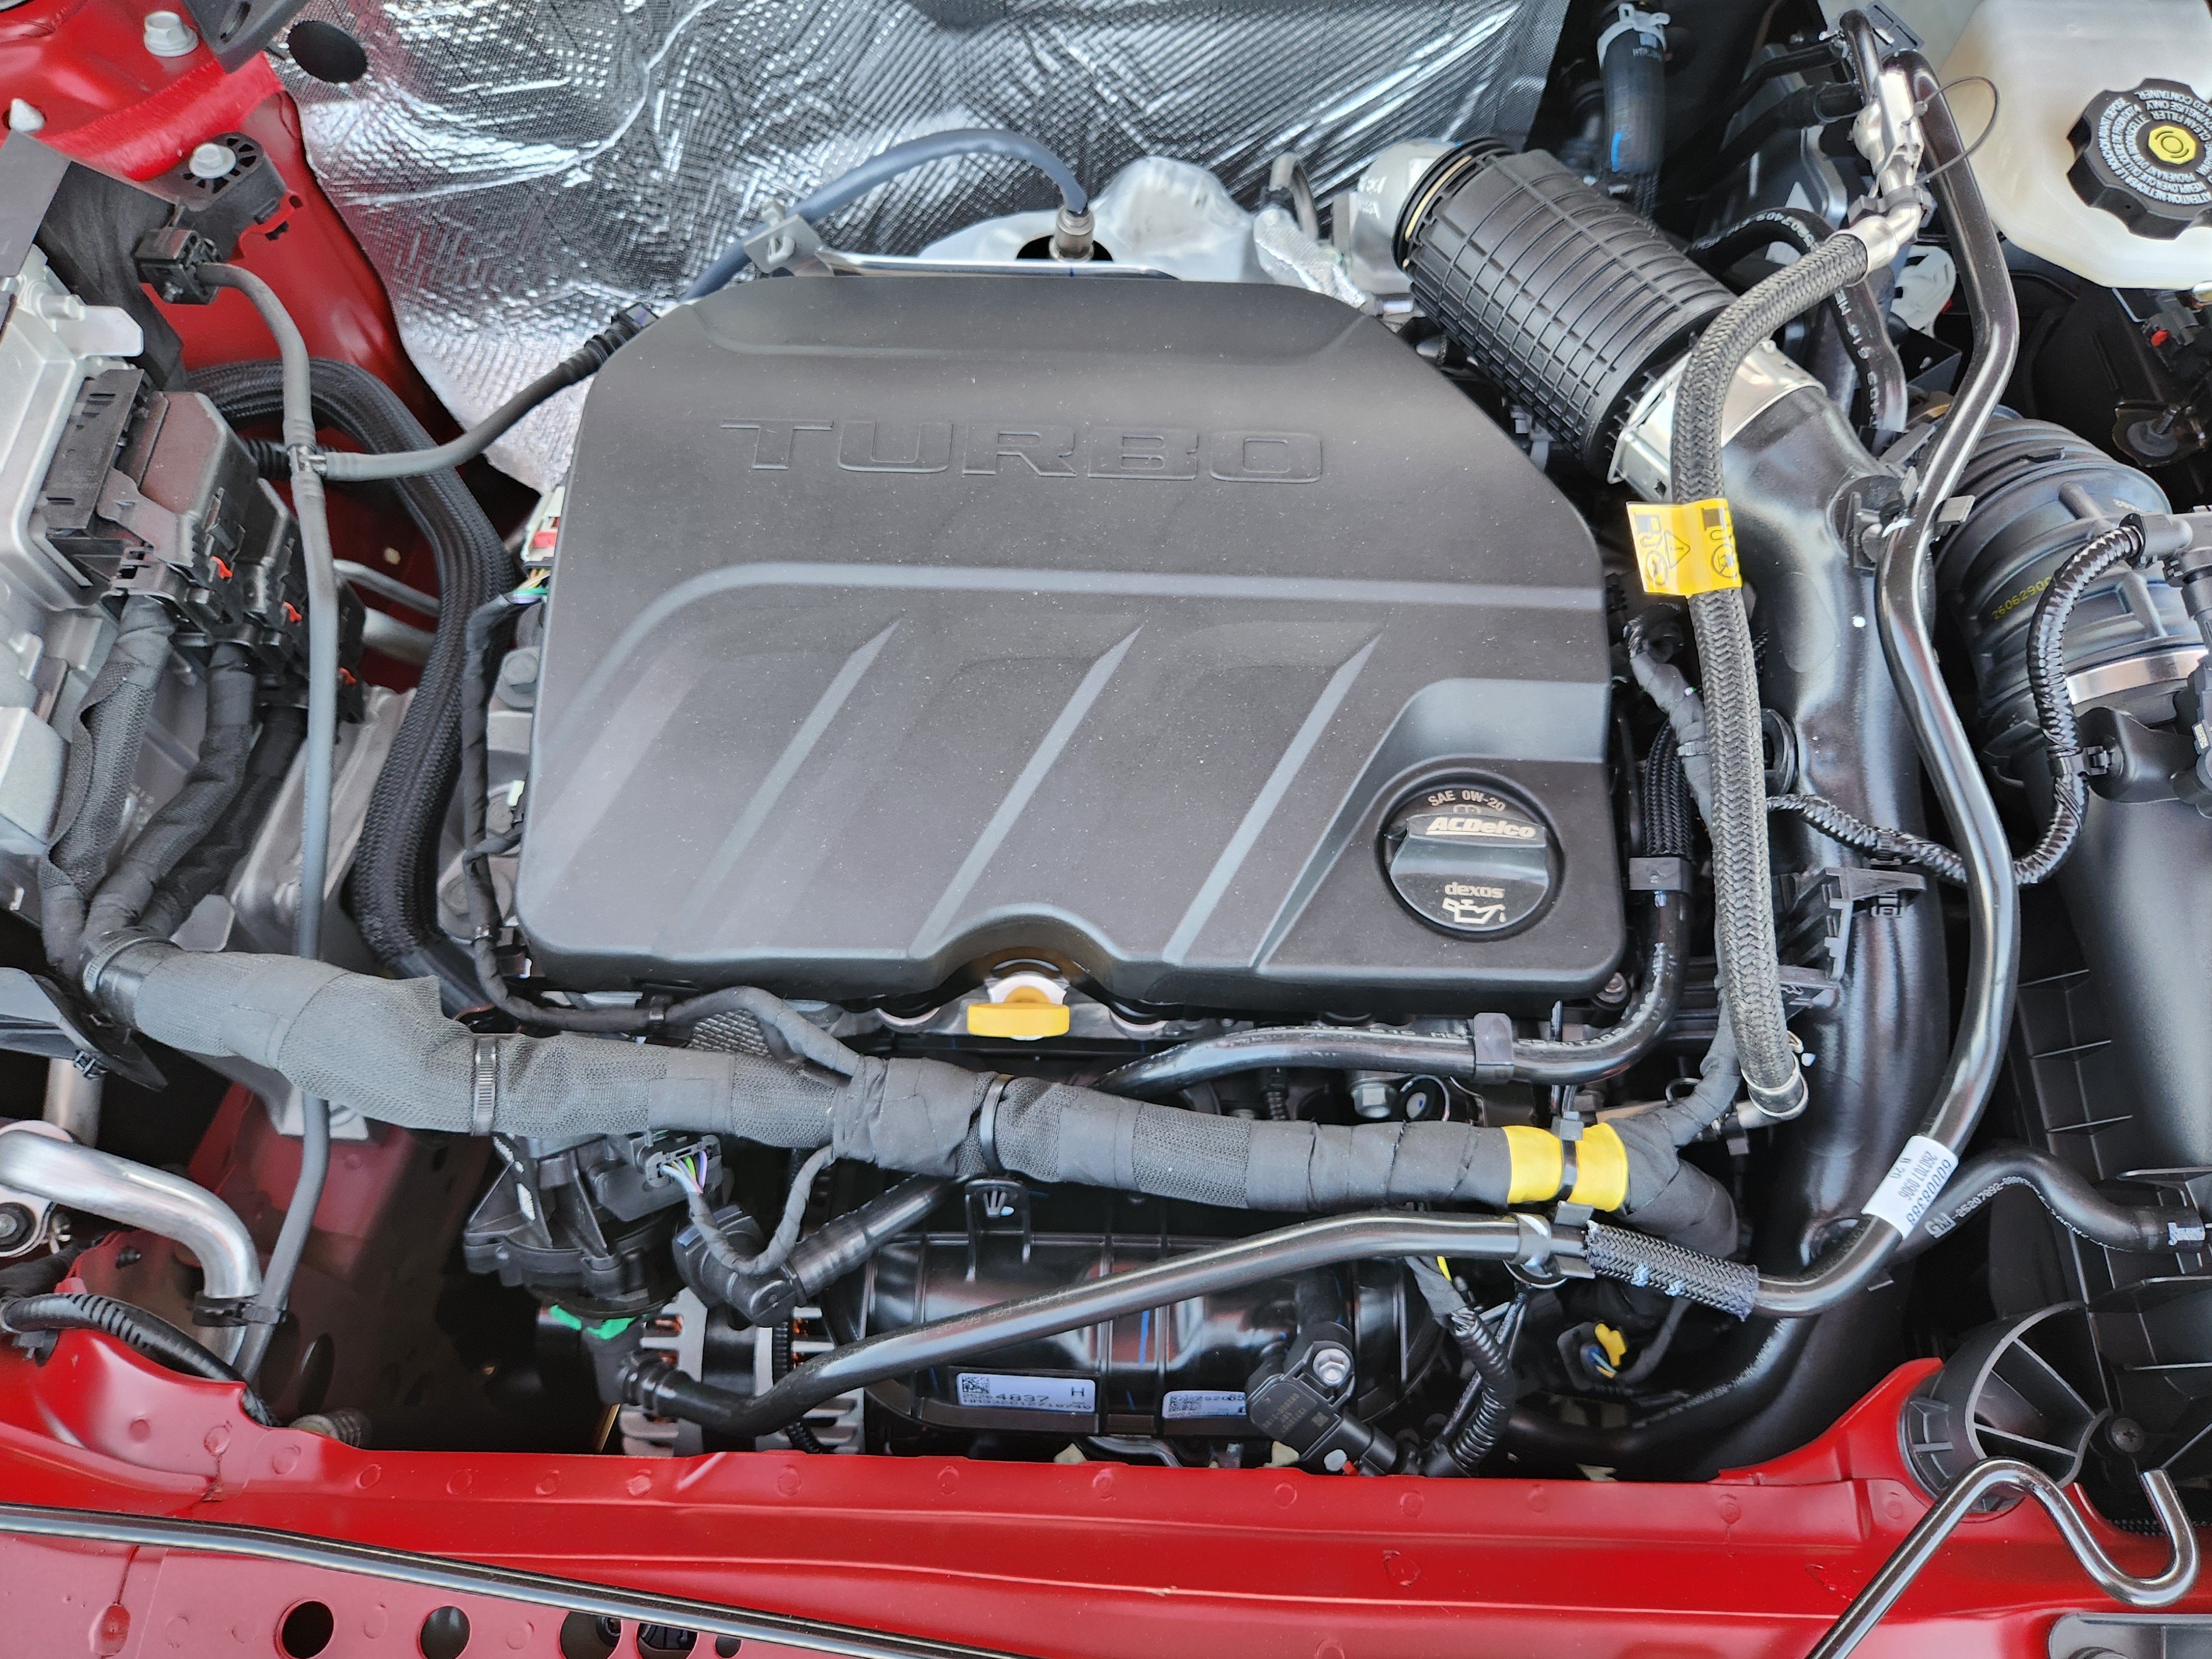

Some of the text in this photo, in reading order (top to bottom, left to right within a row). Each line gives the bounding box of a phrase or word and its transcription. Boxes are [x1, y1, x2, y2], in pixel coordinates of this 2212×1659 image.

[2146, 100, 2169, 111] ONLY
[2150, 110, 2185, 123] FILLER
[2183, 117, 2212, 142] CLEAN
[2114, 167, 2130, 179] LE
[720, 419, 1322, 484] TURBO
[1428, 790, 1506, 812] SAE 0W-20
[1425, 817, 1537, 840] ACDelco
[1444, 882, 1505, 899] dexos
[1924, 1212, 1957, 1239] GM
[1071, 1387, 1085, 1397] H
